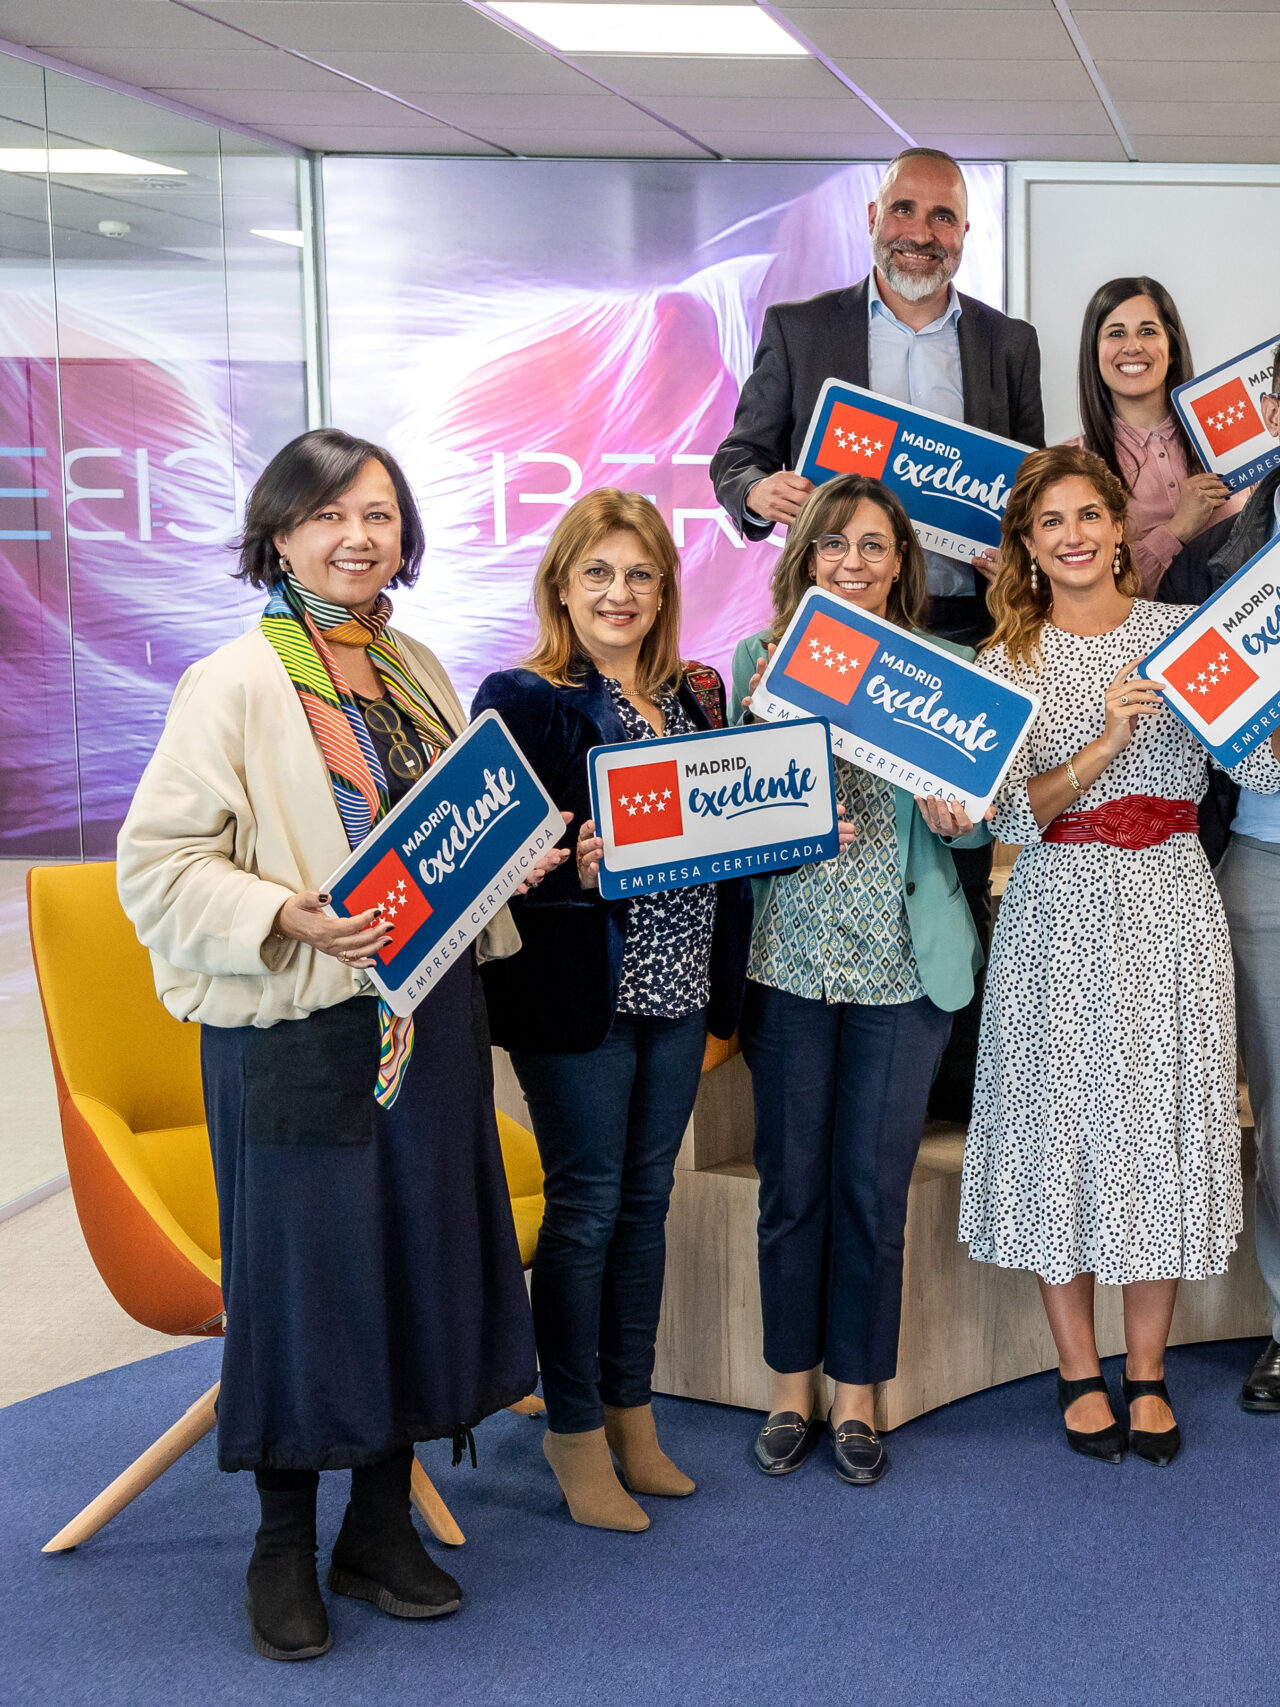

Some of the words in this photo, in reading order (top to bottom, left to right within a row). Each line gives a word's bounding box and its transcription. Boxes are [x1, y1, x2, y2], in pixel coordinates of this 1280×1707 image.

[1248, 366, 1274, 387] MAD
[900, 430, 961, 461] MADRID
[1229, 454, 1280, 488] EMPRES
[1222, 583, 1275, 633] MADRID
[879, 652, 942, 691] MADRID
[866, 674, 999, 752] excelente
[685, 756, 746, 778] MADRID
[688, 758, 817, 817] excelente
[401, 800, 451, 857] MADRID
[418, 766, 515, 884] excelente
[620, 866, 701, 890] EMPRESA
[711, 843, 824, 873] CERTIFICADA
[407, 929, 467, 999] EMPRESA
[471, 829, 554, 924] CERTIFICADA
